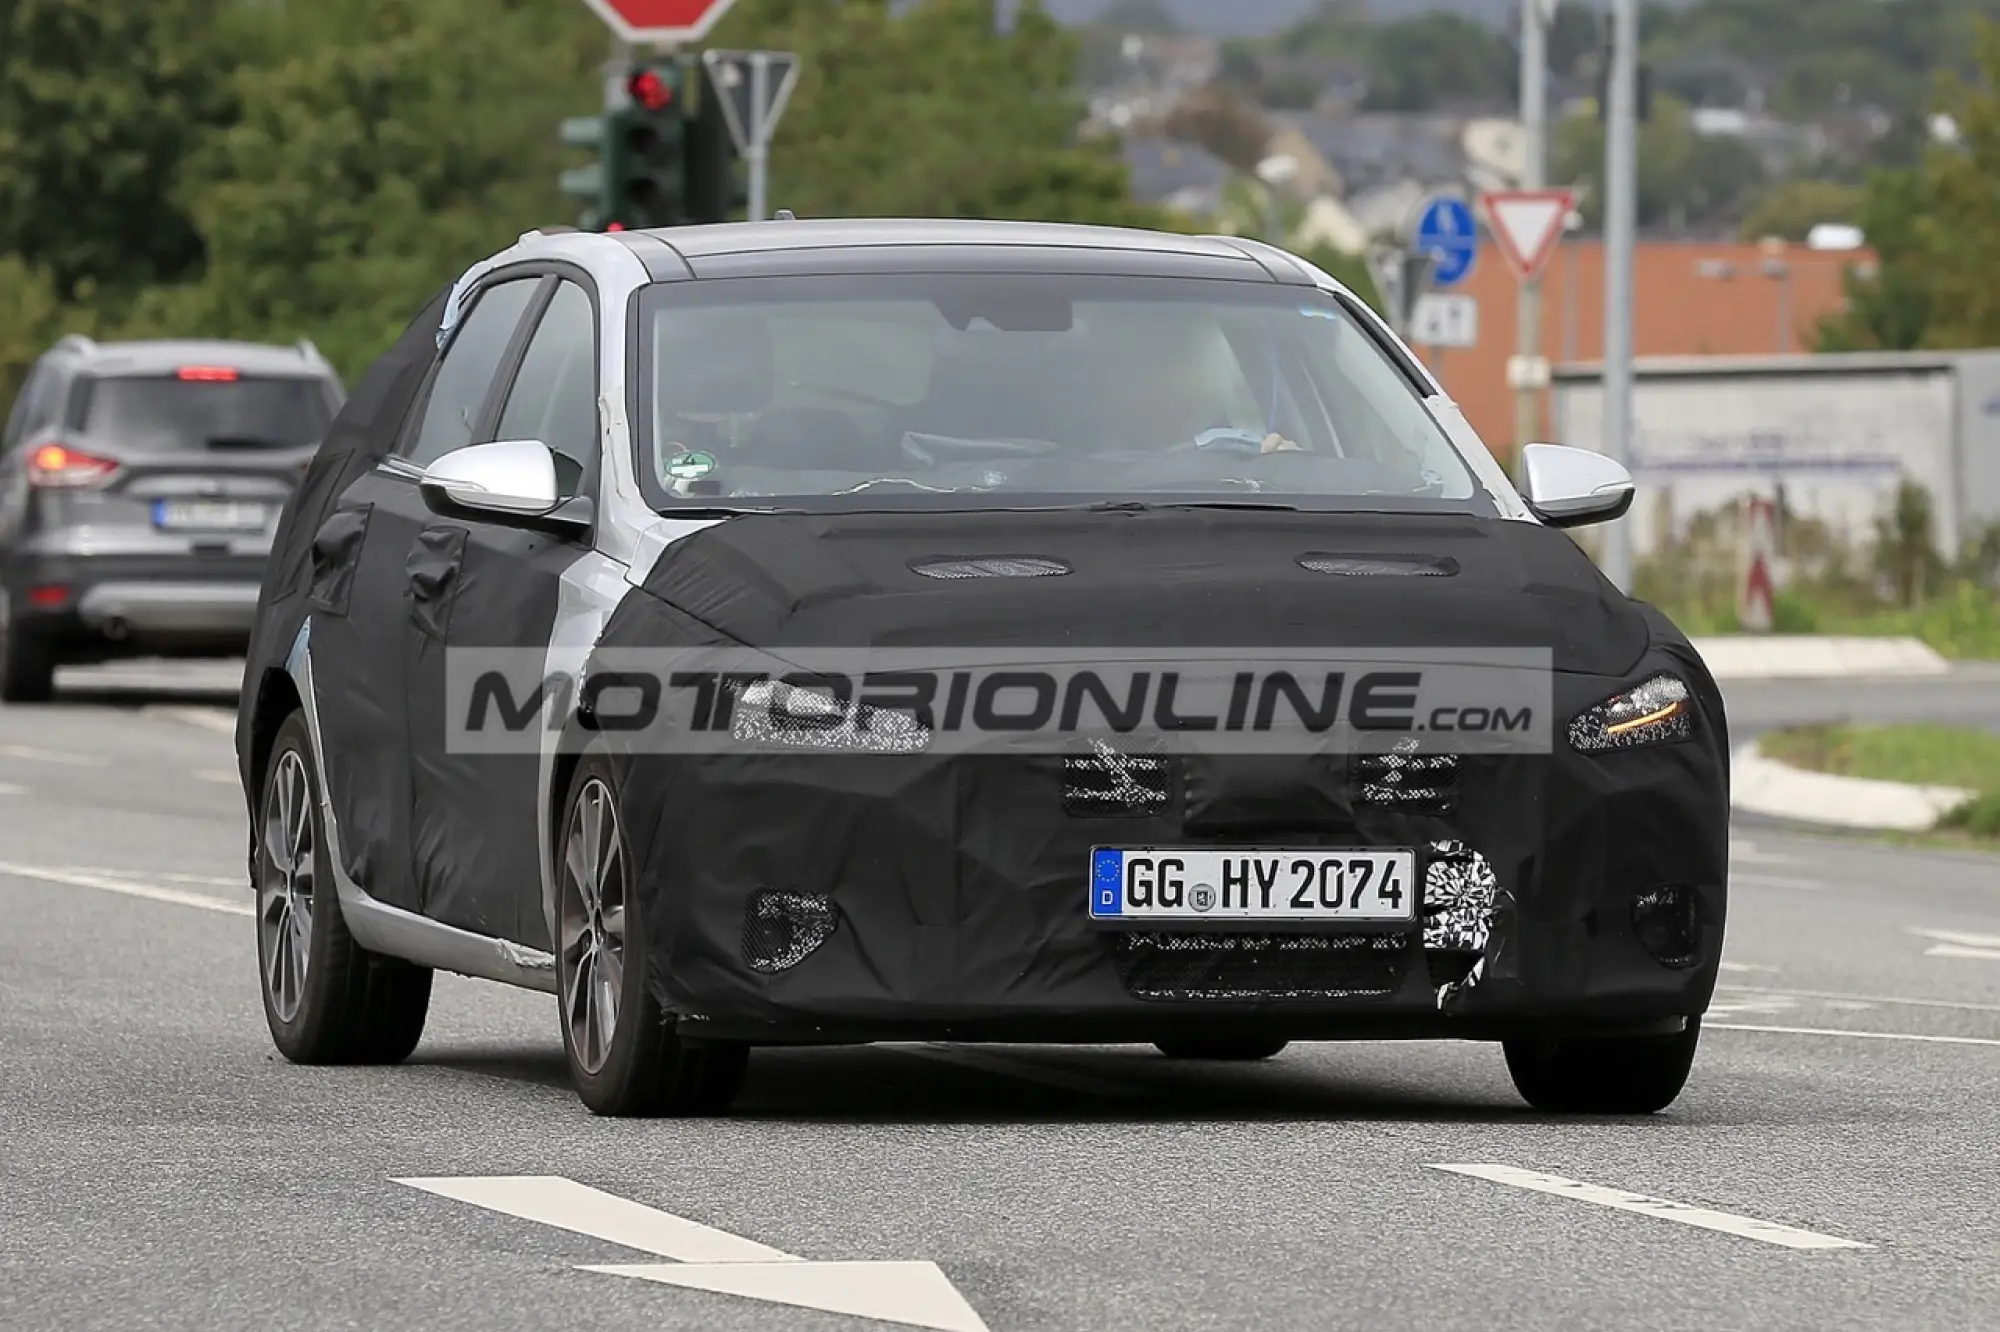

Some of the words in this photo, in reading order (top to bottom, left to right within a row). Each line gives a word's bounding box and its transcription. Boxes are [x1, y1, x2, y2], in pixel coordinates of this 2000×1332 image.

[1101, 890, 1114, 906] D
[1126, 858, 1185, 909] GG
[1221, 859, 1280, 910] HY
[1289, 859, 1403, 910] 2074
